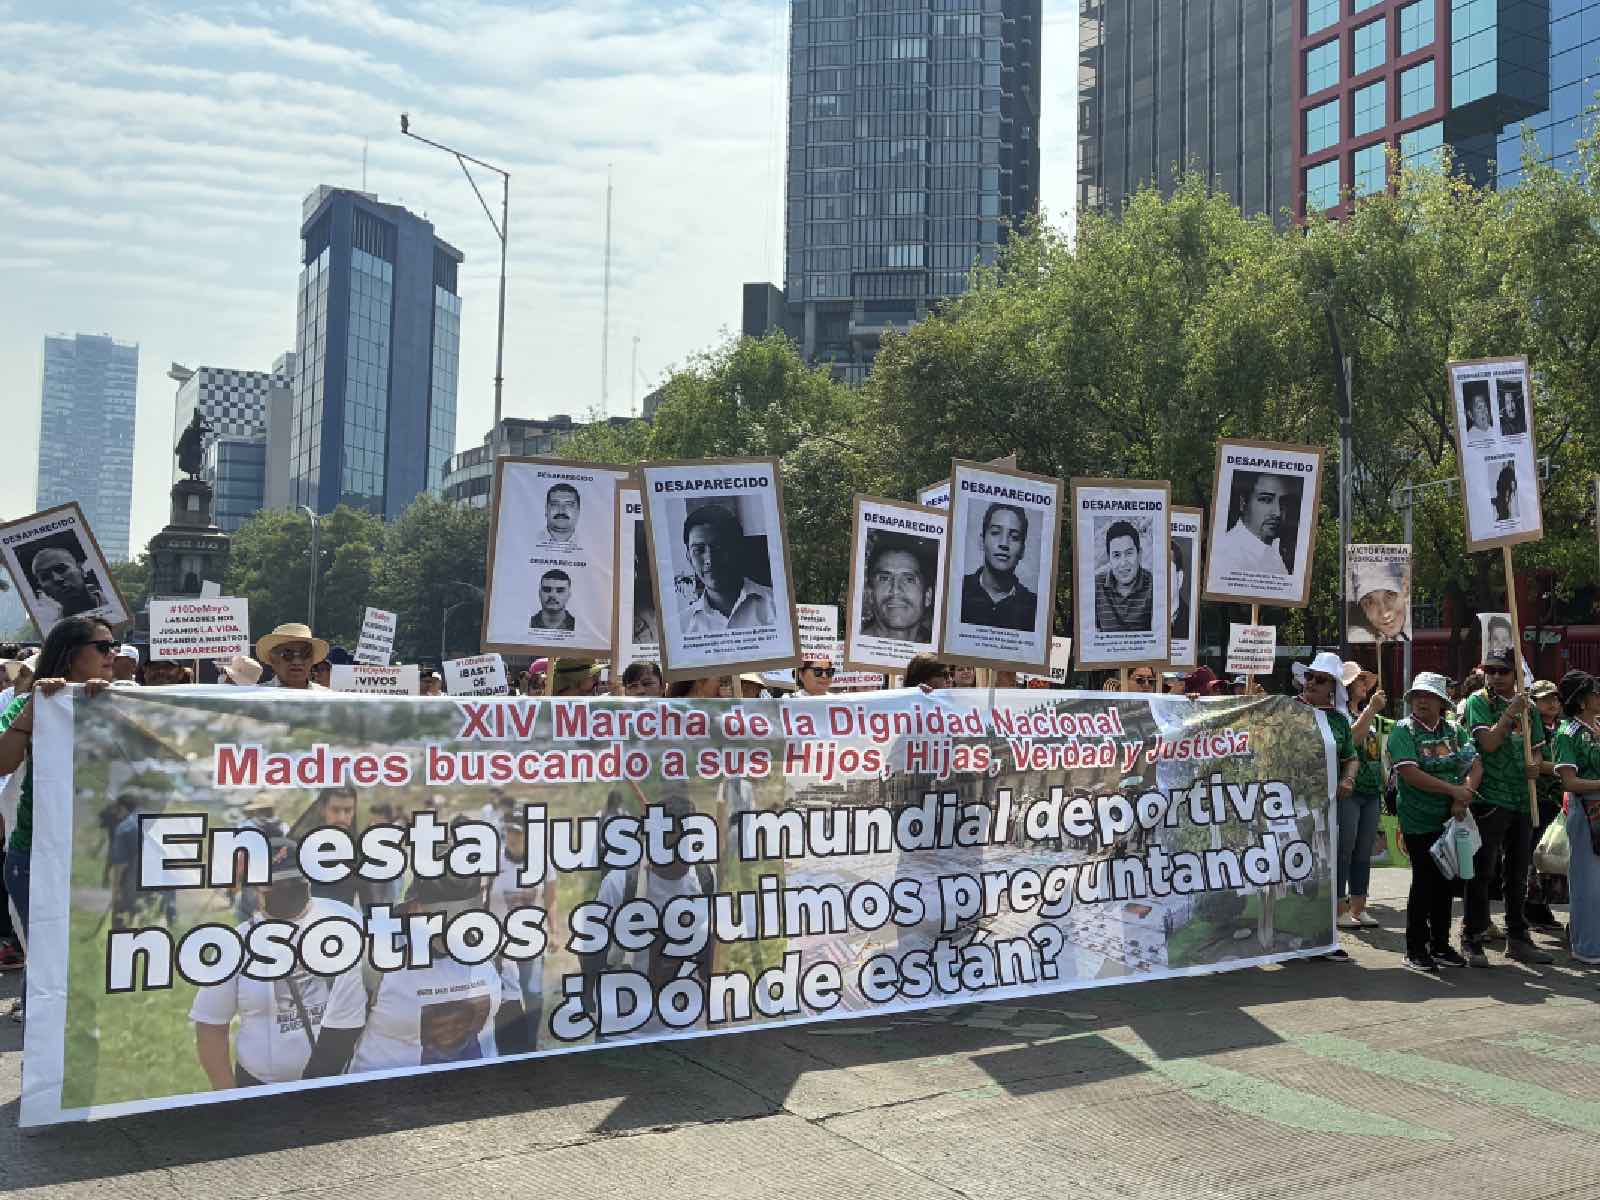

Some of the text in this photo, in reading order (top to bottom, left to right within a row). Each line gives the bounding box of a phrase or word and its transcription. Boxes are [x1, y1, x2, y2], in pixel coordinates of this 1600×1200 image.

[1227, 456, 1313, 473] DESAPARECIDO
[655, 477, 768, 492] DESAPARECIDO
[962, 480, 1052, 505] DESAPARECIDO
[1082, 500, 1162, 511] DESAPARECIDO
[2, 517, 76, 544] DESAPARECIDO
[865, 512, 944, 535] DESAPARECIDO
[160, 645, 241, 656] DESAPARECIDOS
[474, 677, 486, 687] DE
[463, 704, 1123, 746] XIV Marcha de la Dignidad Nacional
[217, 730, 1250, 786] Madres buscando a sus Hijos, Hijas, Verdad y Justicia
[137, 772, 1297, 890] En esta justa mundial deportiva
[105, 832, 1314, 994] nosotros seguimos preguntando
[549, 922, 1064, 1042] ¿Dónde están?
